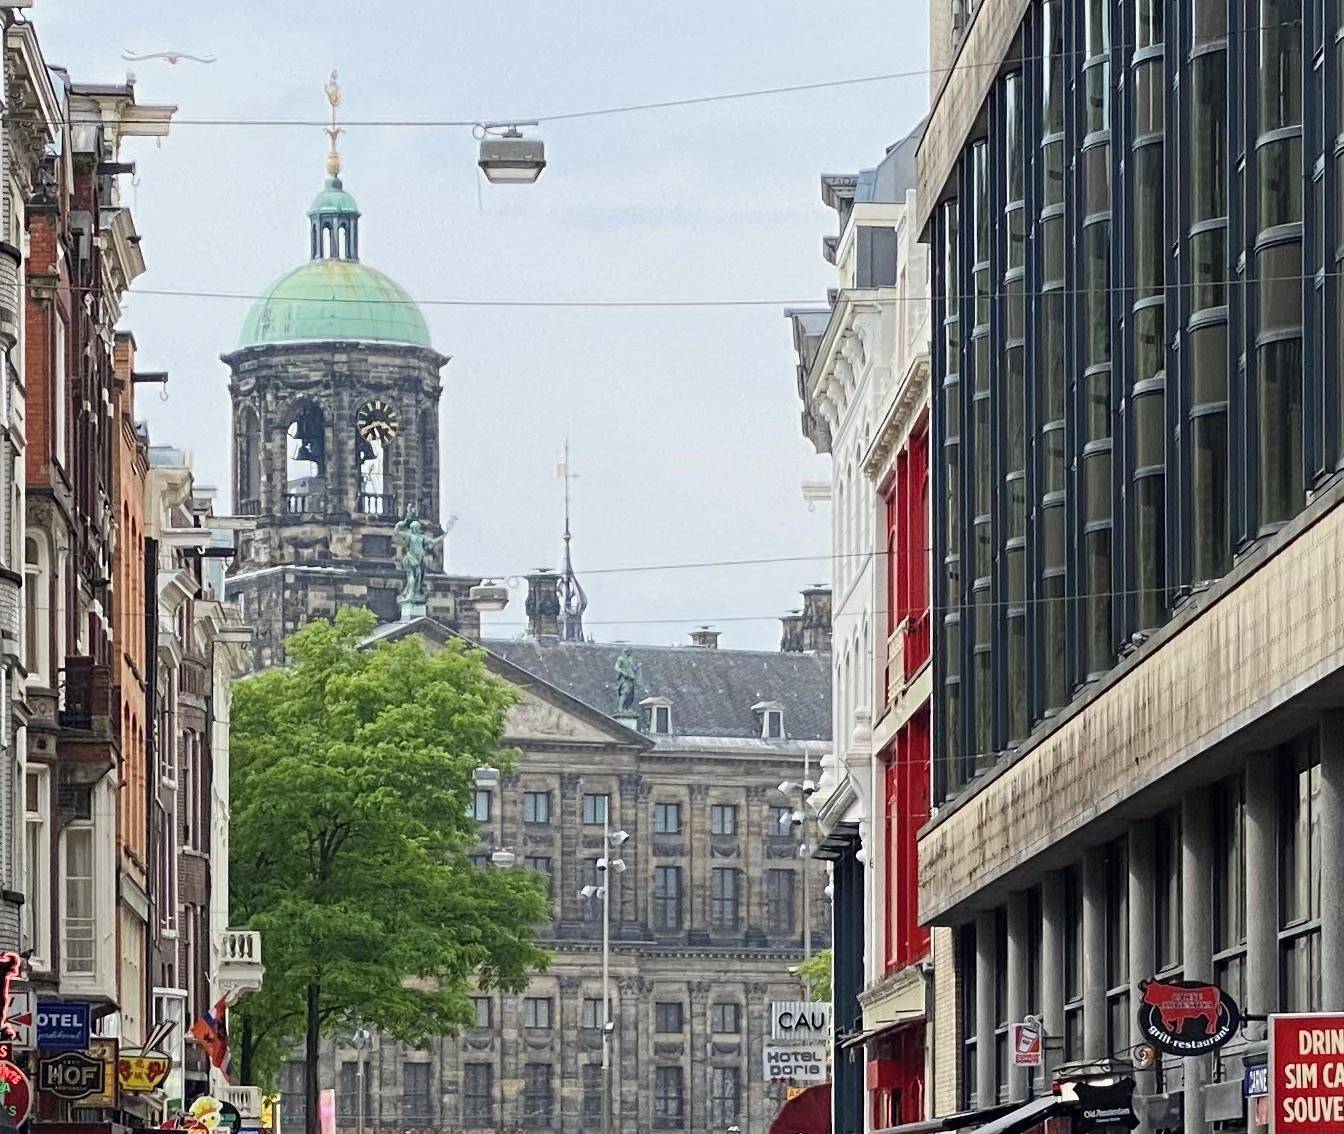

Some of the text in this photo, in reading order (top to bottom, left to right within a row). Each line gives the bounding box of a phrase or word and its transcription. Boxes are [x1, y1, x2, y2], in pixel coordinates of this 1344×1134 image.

[37, 1013, 83, 1027] OTEL
[779, 1012, 825, 1031] CAU
[48, 1063, 97, 1085] HOF
[1284, 1063, 1317, 1089] SIM
